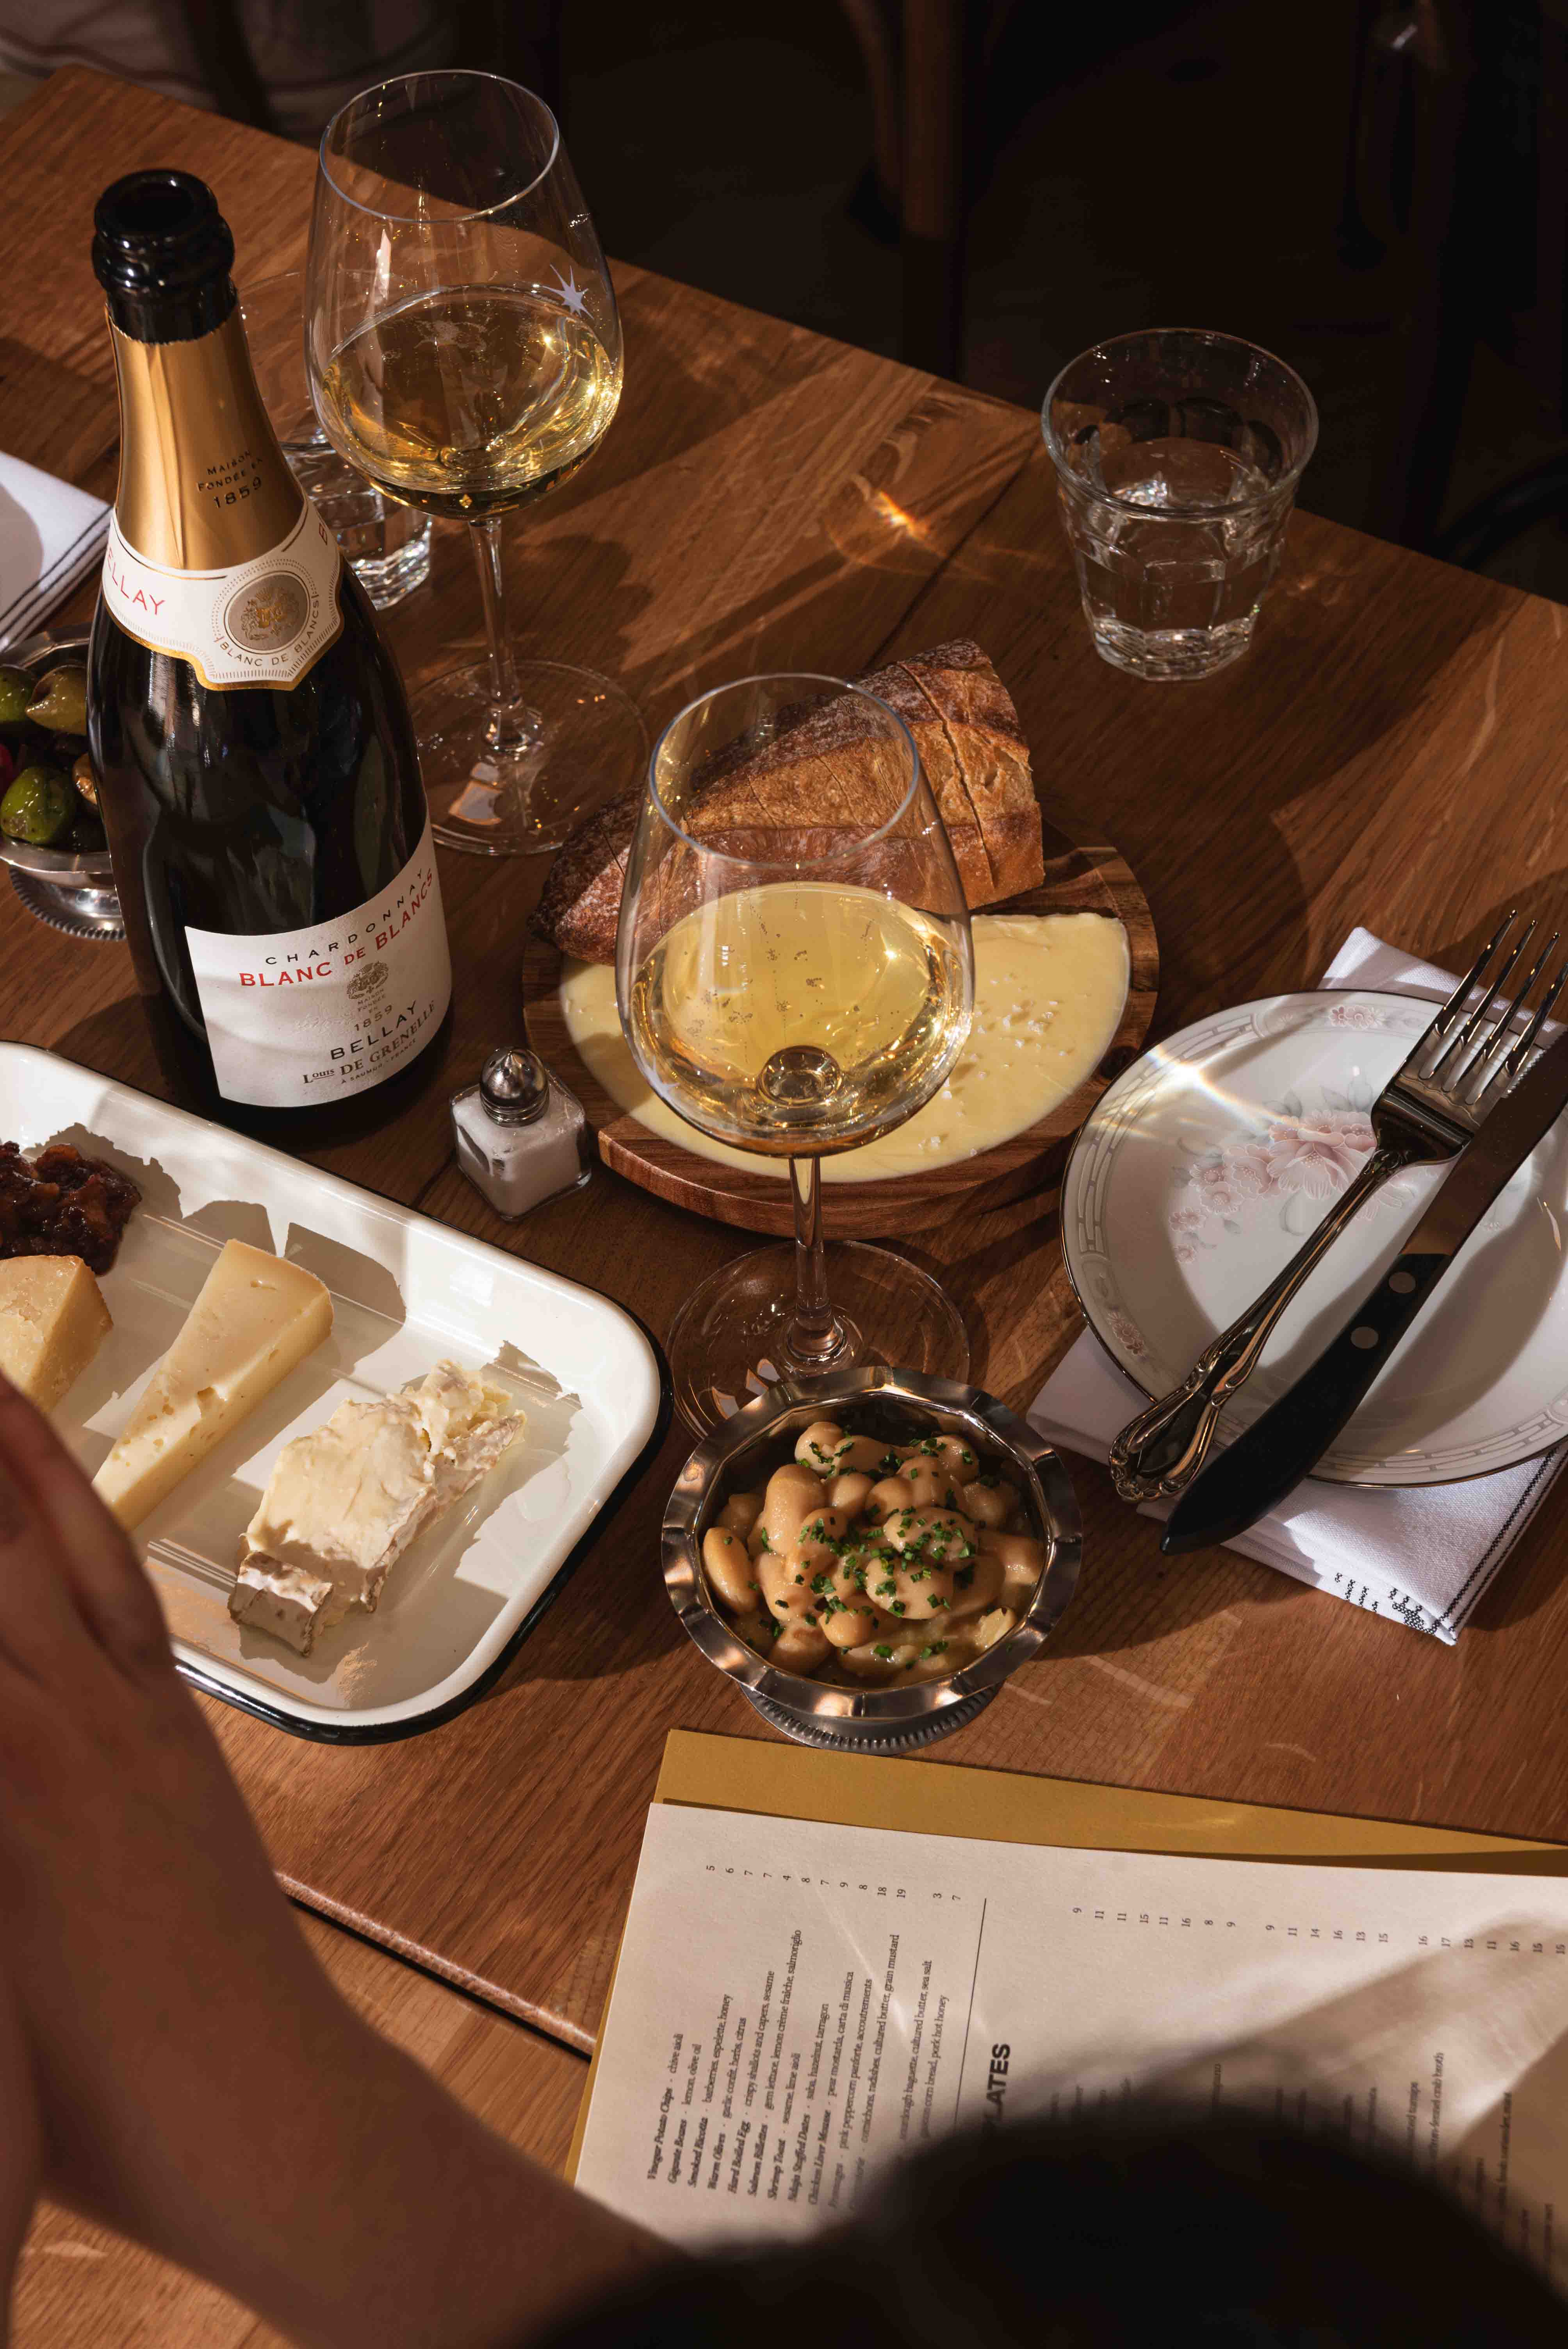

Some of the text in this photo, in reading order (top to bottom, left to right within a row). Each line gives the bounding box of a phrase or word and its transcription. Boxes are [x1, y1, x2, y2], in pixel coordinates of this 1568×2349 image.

[213, 476, 262, 509] 1859
[107, 546, 166, 615] ELLAY
[220, 600, 319, 667] BLANC DE BLANCS
[239, 868, 433, 987] BLANC DE BLANCS
[265, 868, 422, 965] CHARDONNAY
[354, 1004, 392, 1032] 1859
[330, 1000, 417, 1060] BELLAY
[303, 1000, 435, 1084] Louis DE GRENELLE
[878, 1886, 887, 1897] 18
[896, 1889, 906, 1899] 19
[1095, 1911, 1104, 1919] 11
[1117, 1913, 1126, 1921] 11
[1140, 1914, 1149, 1924] 15
[1159, 1916, 1169, 1925] 11
[1181, 1918, 1191, 1927] 16
[1288, 1927, 1297, 1937] 11
[1310, 1928, 1320, 1938] 14
[1333, 1930, 1343, 1940] 16
[1356, 1931, 1365, 1941] 13
[1379, 1933, 1388, 1943] 15
[1418, 1935, 1428, 1946] 16
[1441, 1937, 1451, 1947] 17
[887, 1934, 899, 1969] mustard
[1487, 1941, 1497, 1950] 11
[843, 1971, 854, 2001] musica
[884, 1970, 894, 1992] grain
[717, 1994, 733, 2020] honey
[839, 2002, 849, 2011] di
[857, 1979, 872, 2041] accoutrements
[911, 2019, 923, 2054] cultured
[922, 1960, 932, 1975] salt
[935, 1995, 949, 2022] honey
[837, 2012, 847, 2034] carta
[932, 2023, 943, 2038] hot
[873, 2021, 886, 2055] cultured
[737, 2121, 751, 2138] Egg
[744, 2081, 757, 2107] crispy
[754, 2031, 764, 2048] and
[763, 1971, 774, 2001] sesame
[1432, 2052, 1445, 2077] broth
[764, 2091, 775, 2110] gem
[770, 2033, 784, 2059] lemon
[983, 2043, 1010, 2132] LATES
